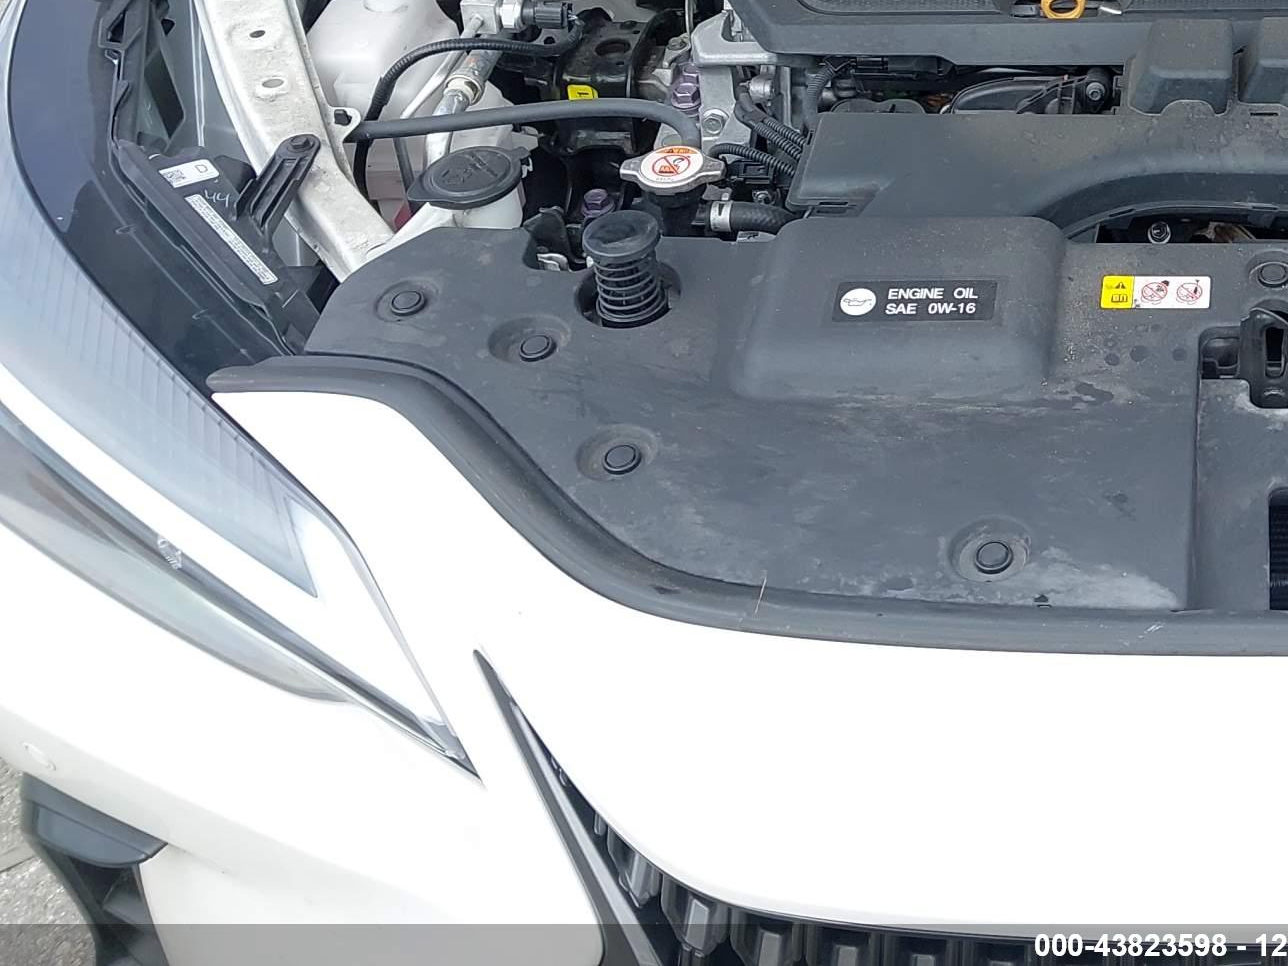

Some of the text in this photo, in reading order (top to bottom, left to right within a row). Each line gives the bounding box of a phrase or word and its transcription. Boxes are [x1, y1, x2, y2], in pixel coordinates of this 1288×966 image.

[888, 287, 978, 299] ENGINE OIL
[885, 302, 976, 314] SAE 0W-16
